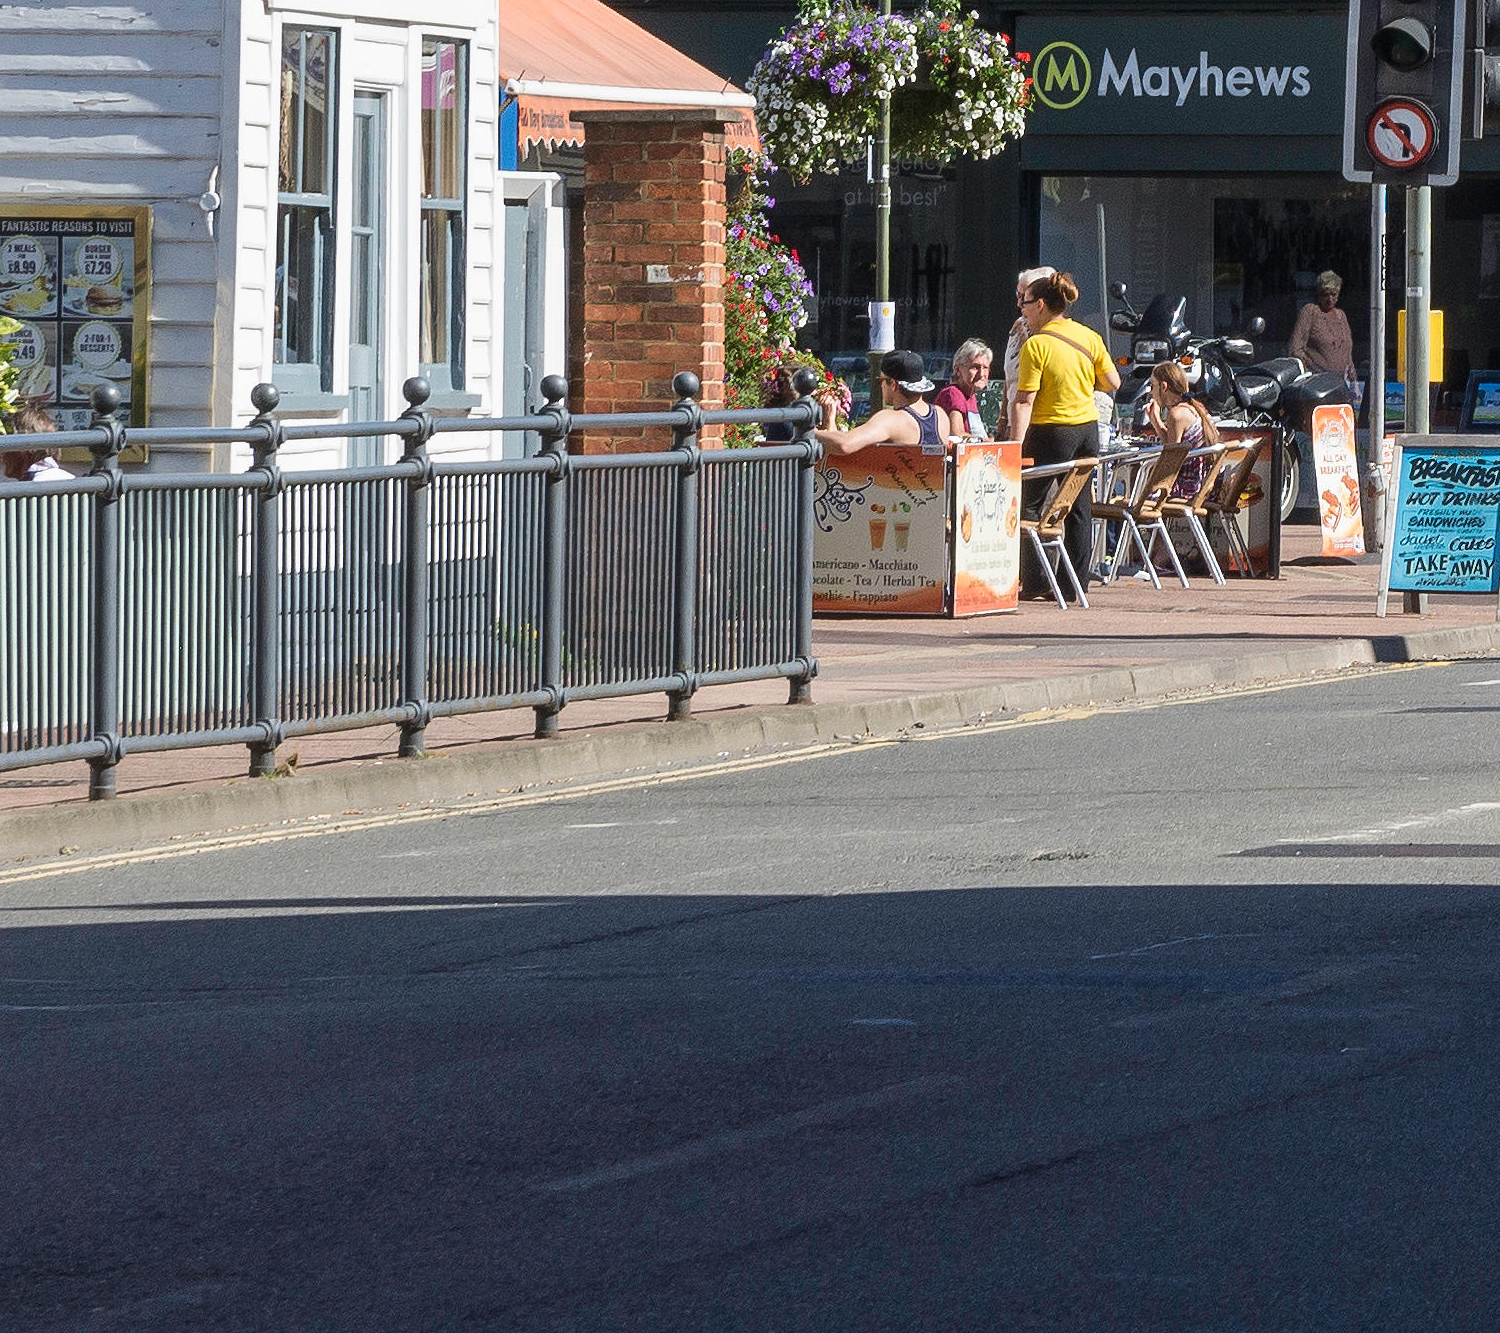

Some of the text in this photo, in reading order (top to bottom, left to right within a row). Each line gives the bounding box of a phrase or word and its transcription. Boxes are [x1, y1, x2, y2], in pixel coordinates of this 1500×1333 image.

[1097, 46, 1311, 107] Mayhews
[1, 221, 50, 232] FANTASTIC
[51, 221, 94, 233] REASONS
[96, 221, 107, 233] TO
[108, 221, 133, 233] VISIT
[8, 260, 37, 275] £8.99
[84, 260, 112, 276] £7.29
[1406, 491, 1500, 506] HOT DRINKS
[1407, 516, 1486, 528] SANDWICHES
[1449, 537, 1495, 552] Cakes
[868, 559, 919, 571] Macchiato
[1404, 554, 1494, 578] TAKE AWAY
[854, 574, 872, 586] Tea
[883, 574, 917, 587] Herbal
[918, 576, 937, 588] Tea
[853, 589, 899, 605] Frappiato
